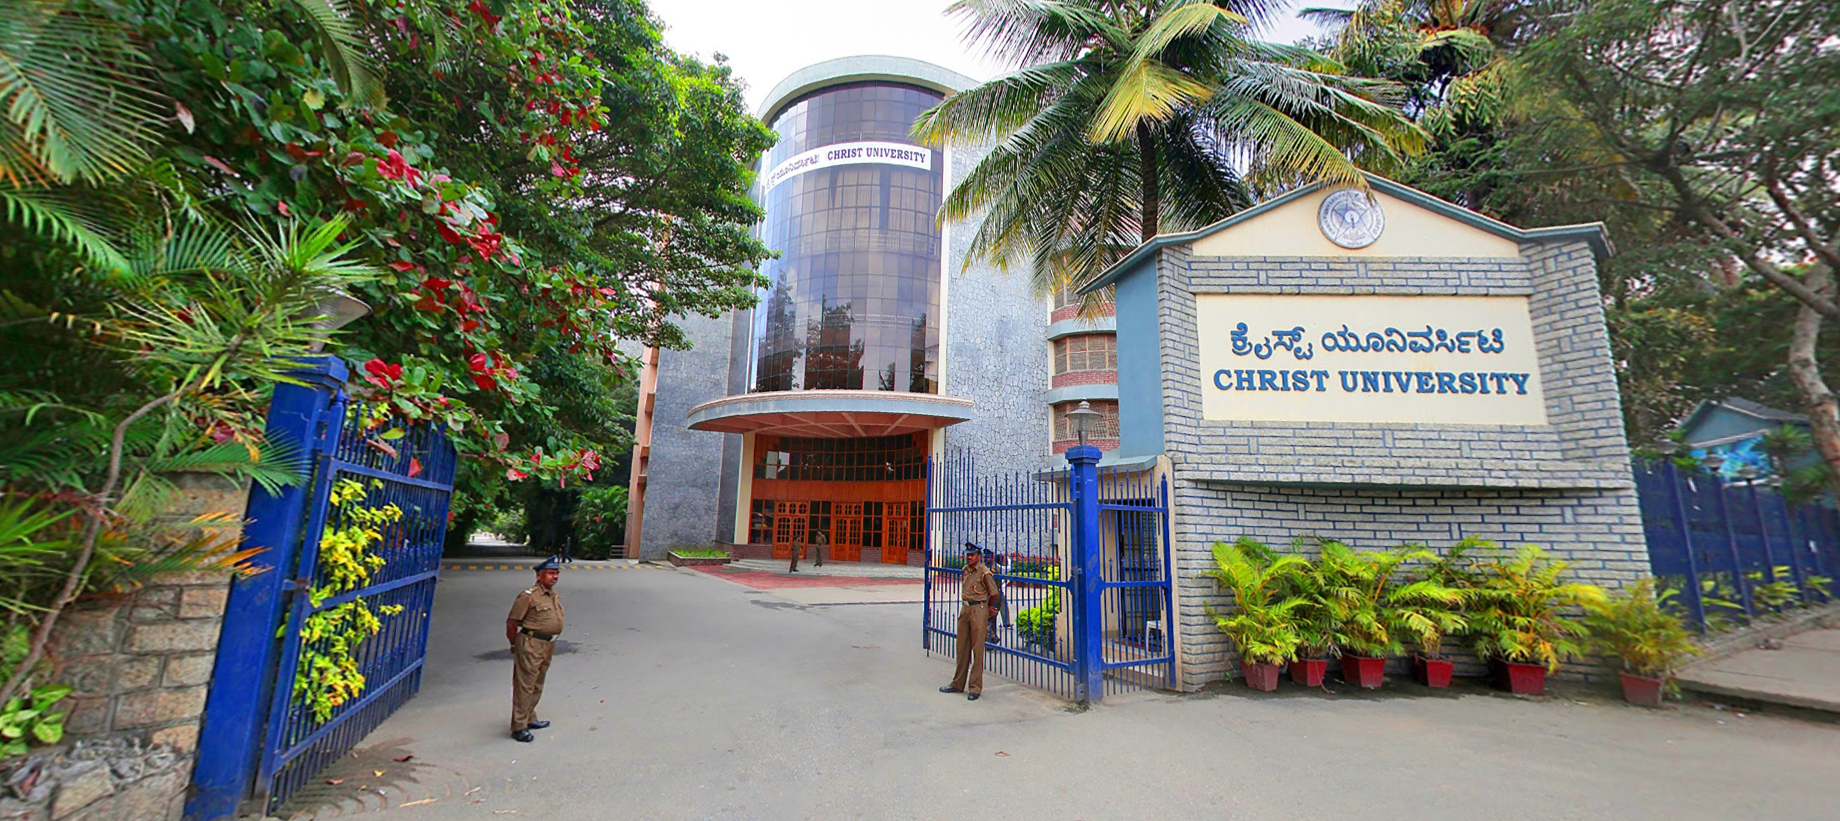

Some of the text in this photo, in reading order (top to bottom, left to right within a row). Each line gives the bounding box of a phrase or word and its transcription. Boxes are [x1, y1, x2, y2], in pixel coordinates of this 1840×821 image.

[827, 147, 927, 163] CHRIST UNIVERSITY
[1213, 369, 1531, 395] CHRIST UNIVERSITY
